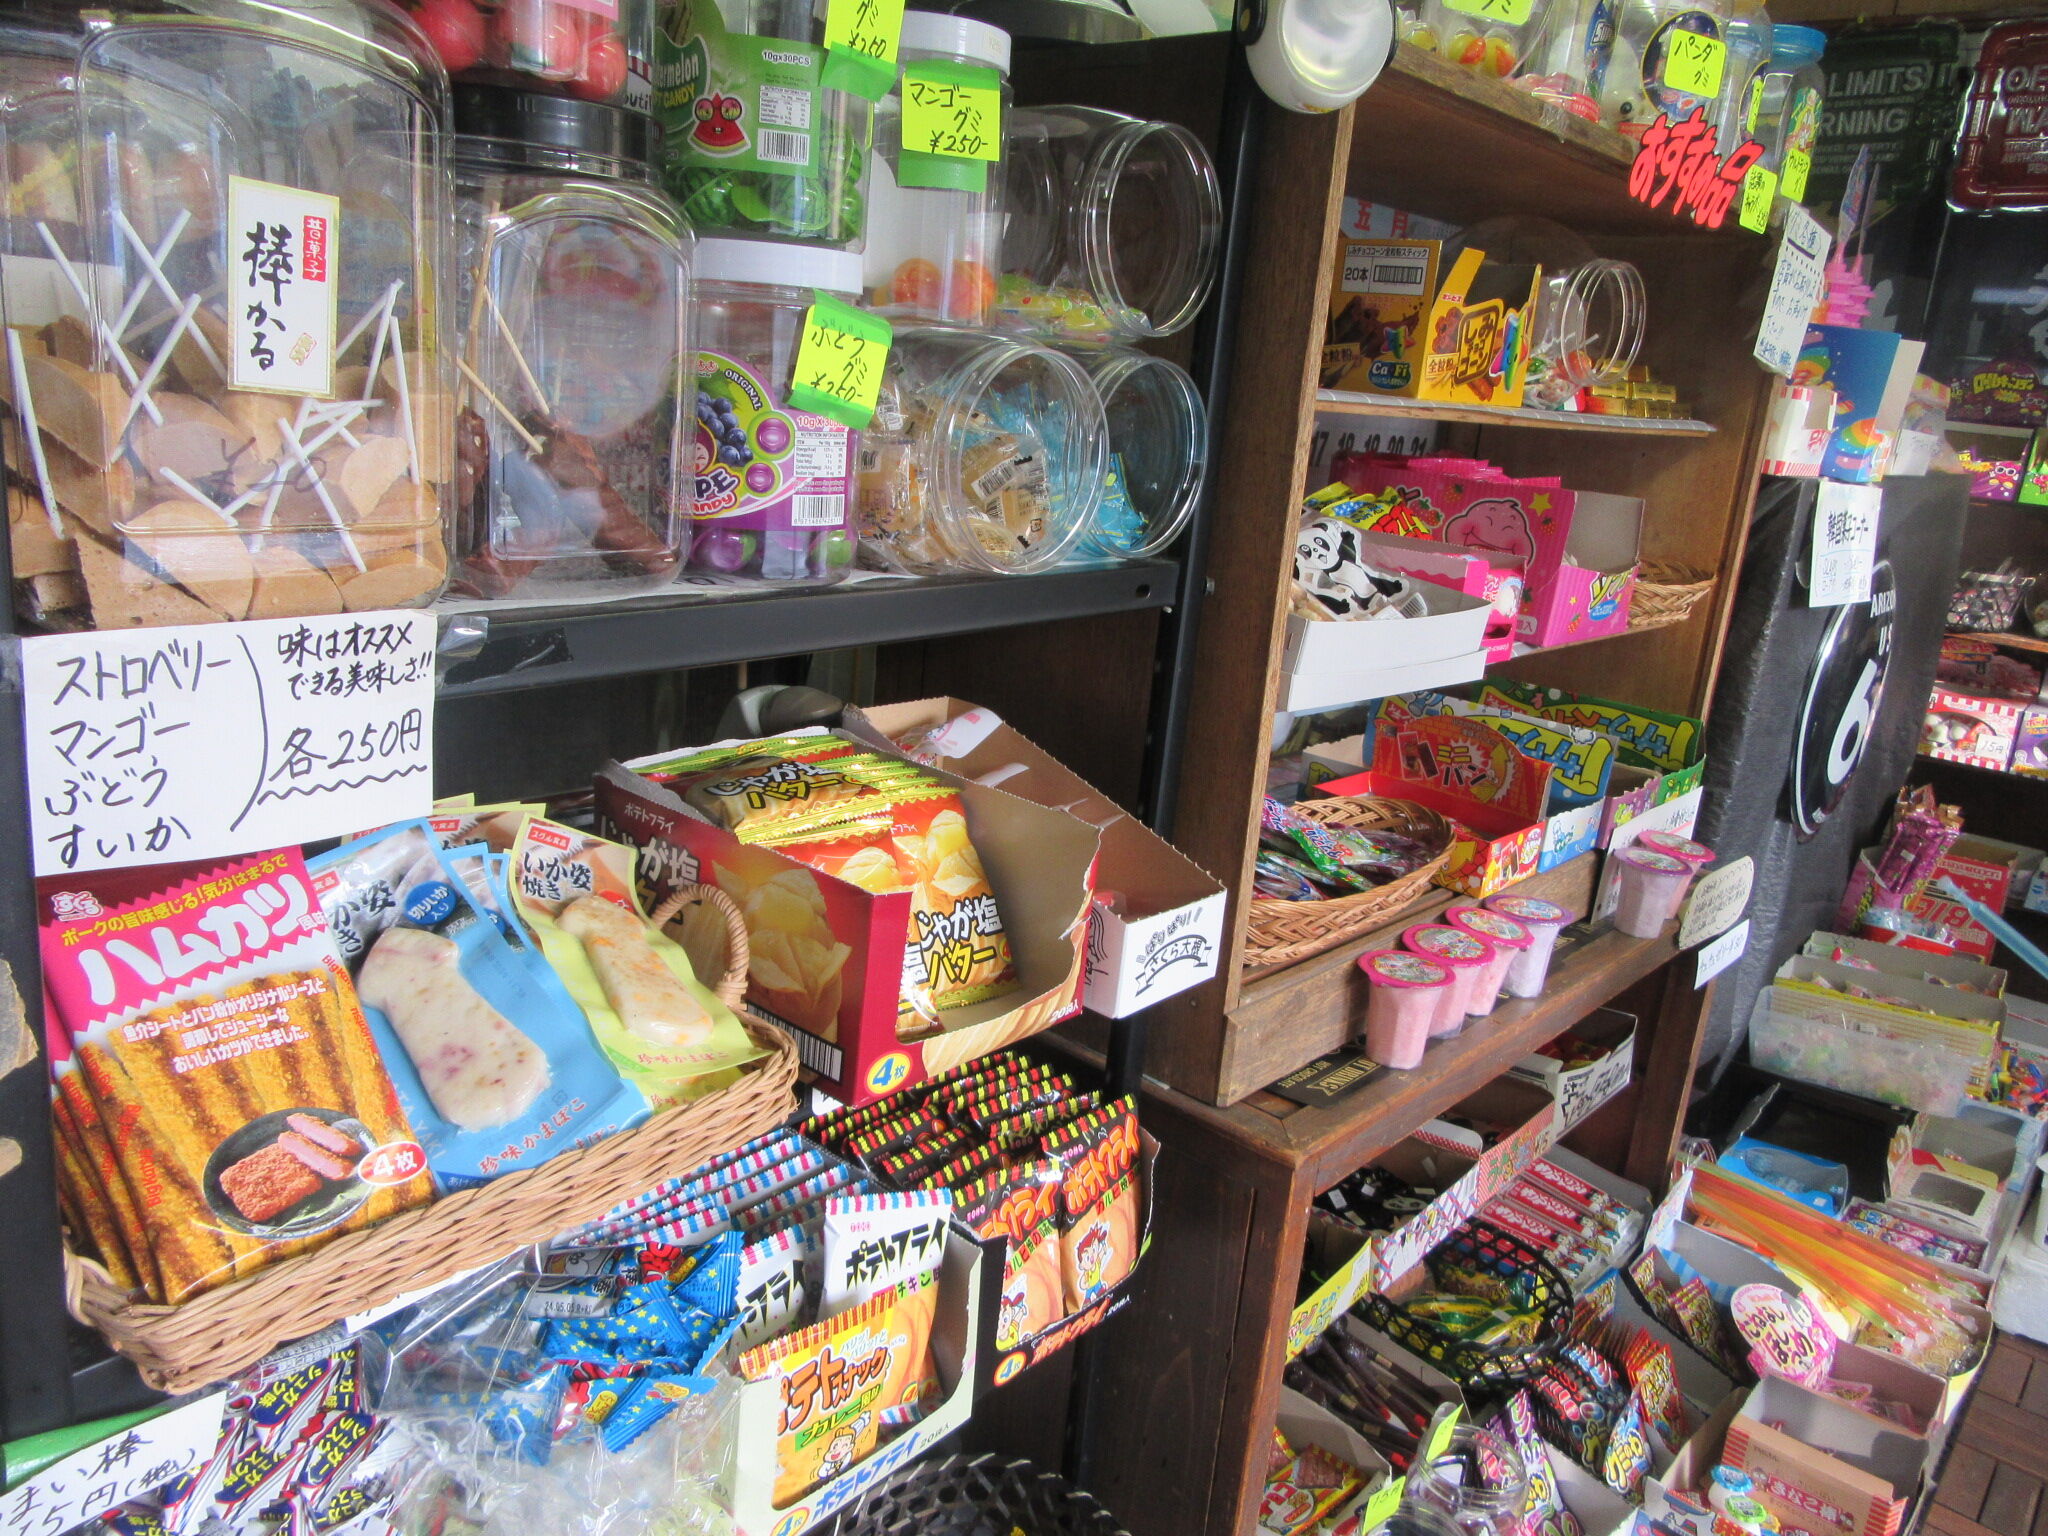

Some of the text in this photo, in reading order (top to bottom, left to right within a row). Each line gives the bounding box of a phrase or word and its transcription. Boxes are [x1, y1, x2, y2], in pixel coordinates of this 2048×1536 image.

[1673, 35, 1719, 63] パンダ
[909, 82, 972, 109] マンゴー
[1828, 63, 1927, 97] LIMITS
[952, 107, 984, 133] グミ
[1629, 105, 1765, 229] おすすめ品
[303, 217, 326, 279] 昔菓子
[1344, 268, 1369, 281] 20本
[1463, 312, 1494, 344] しみ
[842, 356, 868, 386] グミ
[1372, 364, 1389, 376] Ca
[1458, 351, 1490, 378] コーン
[723, 368, 763, 411] ORIGINAL
[277, 620, 413, 667] 味はオススメ
[53, 638, 231, 706] ストロベリー
[49, 701, 190, 766] マンゴー
[1826, 658, 1877, 785] 6
[268, 708, 421, 782] 各250円
[45, 755, 168, 816] ぶどう
[746, 776, 843, 809] バター
[624, 802, 675, 834] ポテトフライ
[48, 816, 192, 869] すいか
[522, 851, 593, 892] いか姿
[522, 874, 561, 901] 焼き
[297, 910, 330, 932] 風味
[407, 884, 450, 921] 切りいか
[913, 894, 1003, 949] じゃが塩
[78, 873, 309, 1006] ハムカツ
[927, 941, 997, 990] バター
[637, 1051, 729, 1066] 珍味かまぼこ
[873, 1057, 905, 1087] 4枚
[1319, 1066, 1365, 1090] DRINKS
[479, 1096, 588, 1174] 珍味かまぼこ
[1062, 1143, 1084, 1160] TOHO
[371, 1151, 418, 1178] 4枚
[1062, 1112, 1140, 1216] ポテトフライ
[845, 1217, 946, 1292] ポテトフライ
[1030, 1297, 1112, 1366] ポテトフライ
[999, 1358, 1021, 1379] 4枚
[0, 1430, 154, 1527] まい棒
[812, 1431, 921, 1522] ポテトフライ
[1769, 1480, 1841, 1523] きなこ棒
